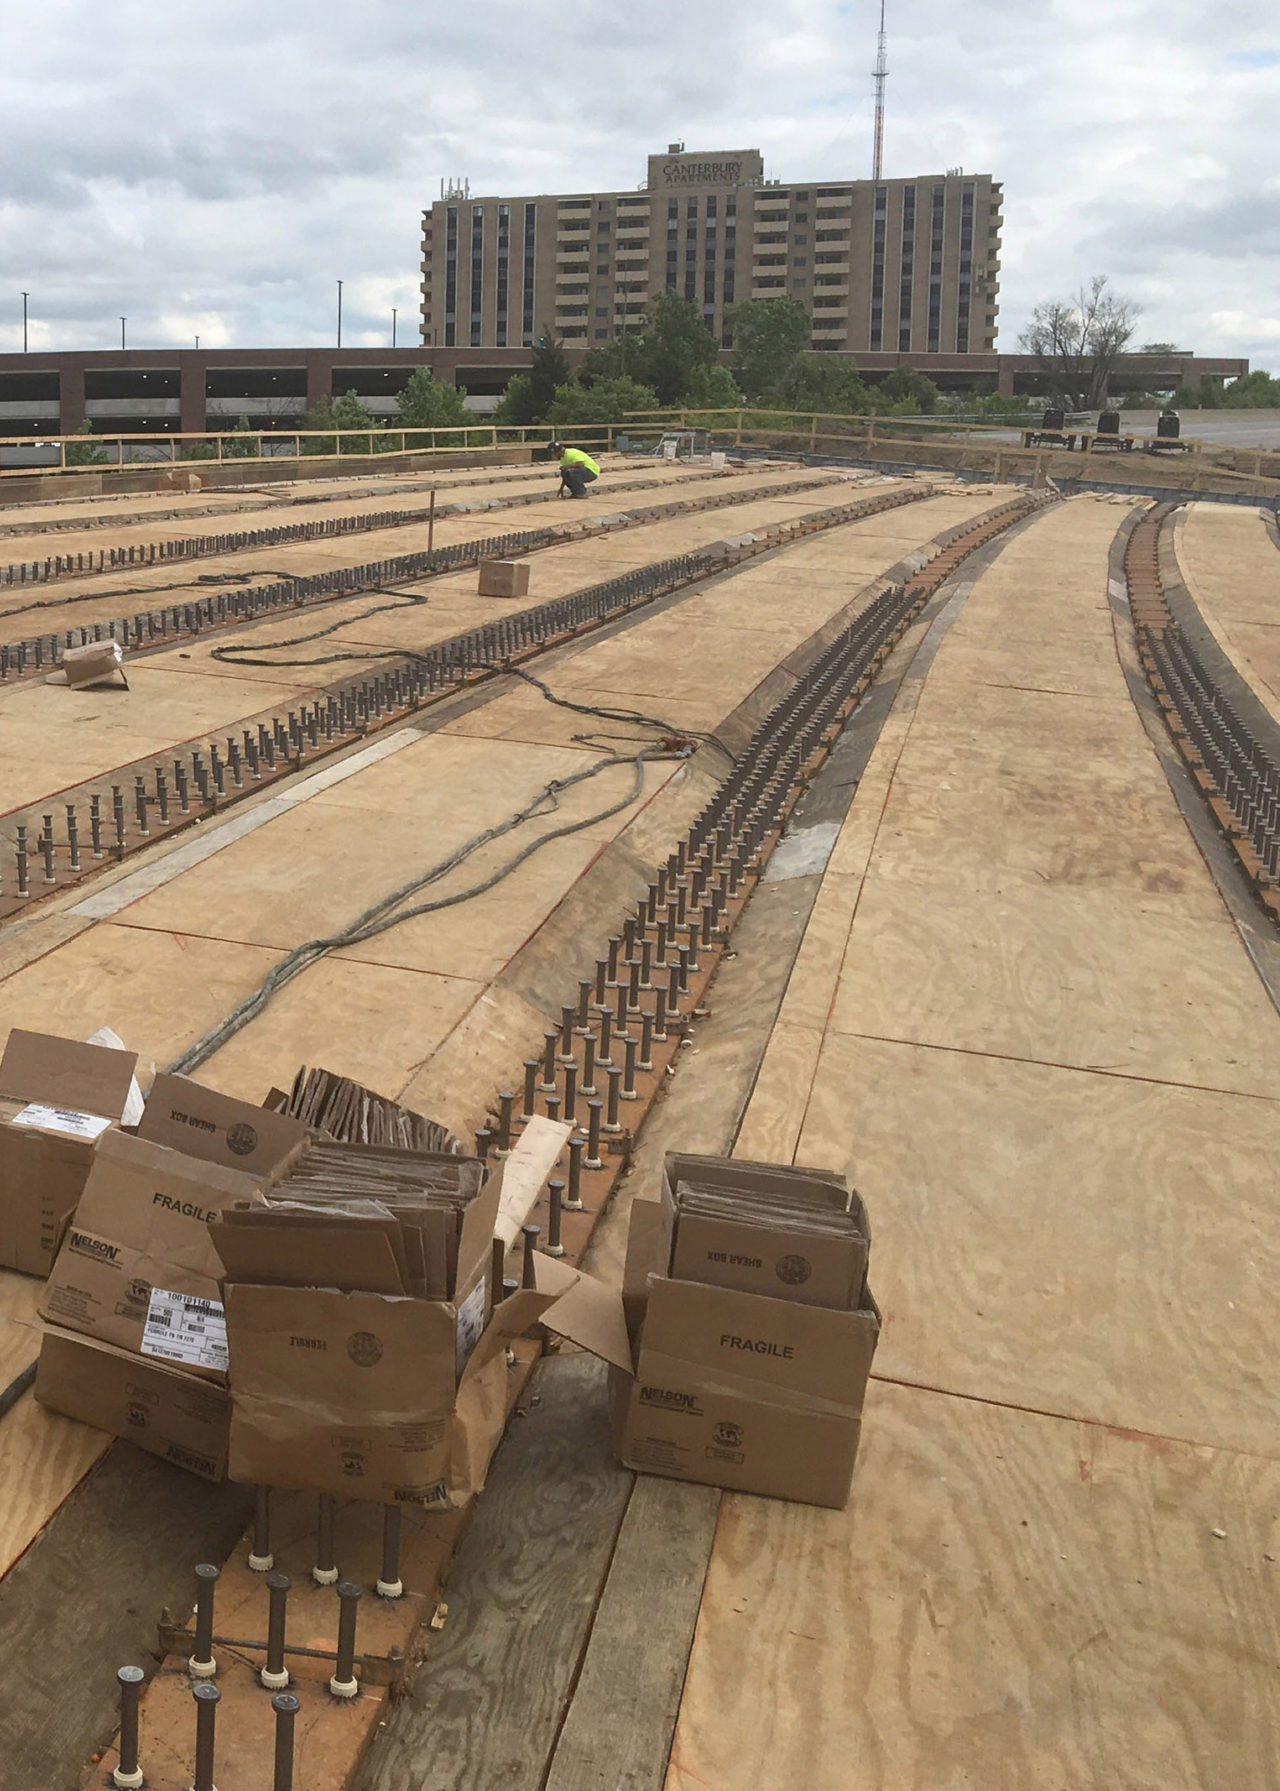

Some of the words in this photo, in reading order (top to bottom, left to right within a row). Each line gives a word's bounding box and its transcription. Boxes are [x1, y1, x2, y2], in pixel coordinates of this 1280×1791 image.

[663, 161, 742, 176] CANTERBURY
[665, 172, 740, 184] APARTMENTS
[169, 1109, 189, 1124] BOX
[188, 1115, 217, 1133] SHEAR
[152, 1192, 218, 1225] FRAGILE
[71, 1232, 118, 1260] NELSON
[707, 1250, 727, 1263] BOX
[729, 1254, 762, 1269] SHEAR
[720, 1334, 795, 1360] FRAGILE
[641, 1386, 695, 1408] NELSON
[394, 1483, 448, 1504] NELSON
